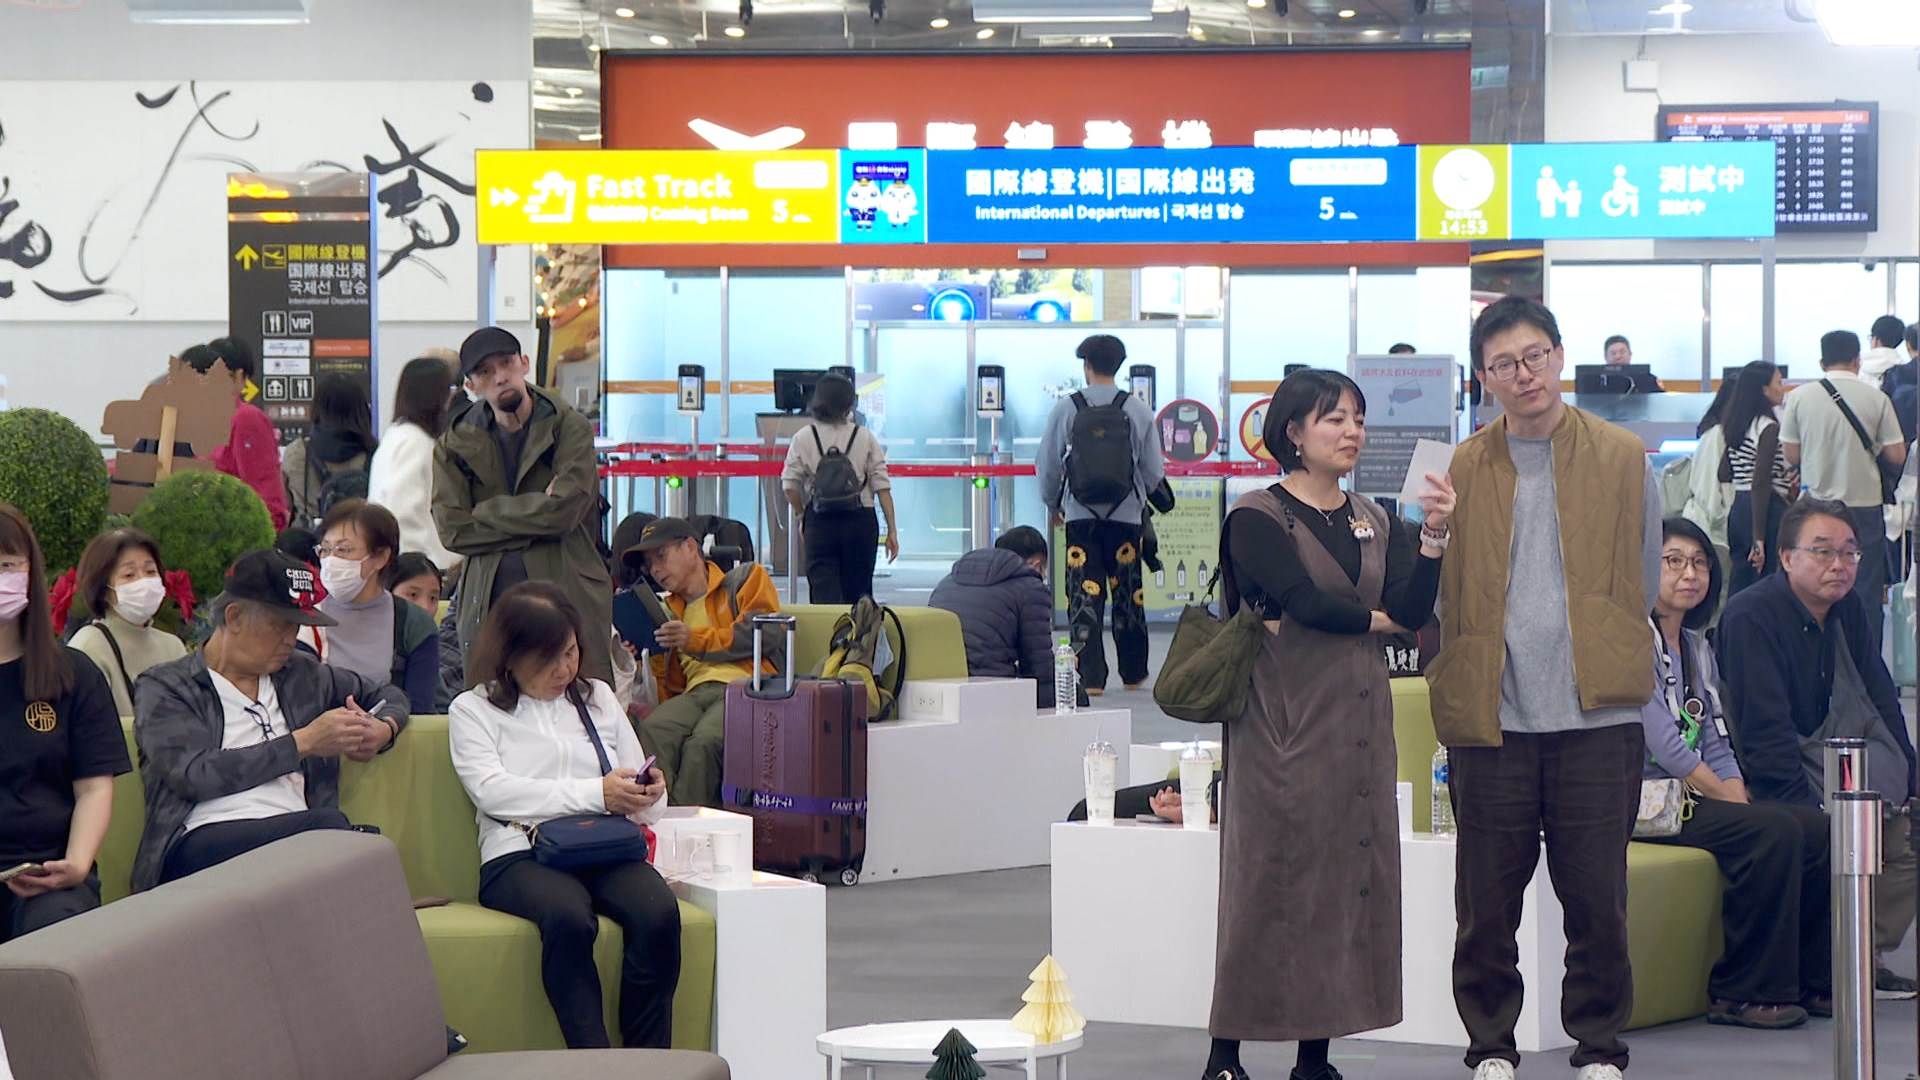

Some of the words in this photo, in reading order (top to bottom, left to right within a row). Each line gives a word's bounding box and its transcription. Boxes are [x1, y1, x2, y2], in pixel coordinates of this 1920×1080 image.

[587, 174, 646, 199] Fast
[653, 172, 733, 199] Track
[772, 199, 789, 223] 5
[975, 204, 1074, 220] International
[1076, 204, 1160, 222] Departures
[1319, 197, 1335, 221] 5
[1439, 219, 1488, 236] 14:53
[288, 280, 331, 295] 국제선
[339, 280, 368, 295] 탑승
[291, 318, 311, 330] VIP
